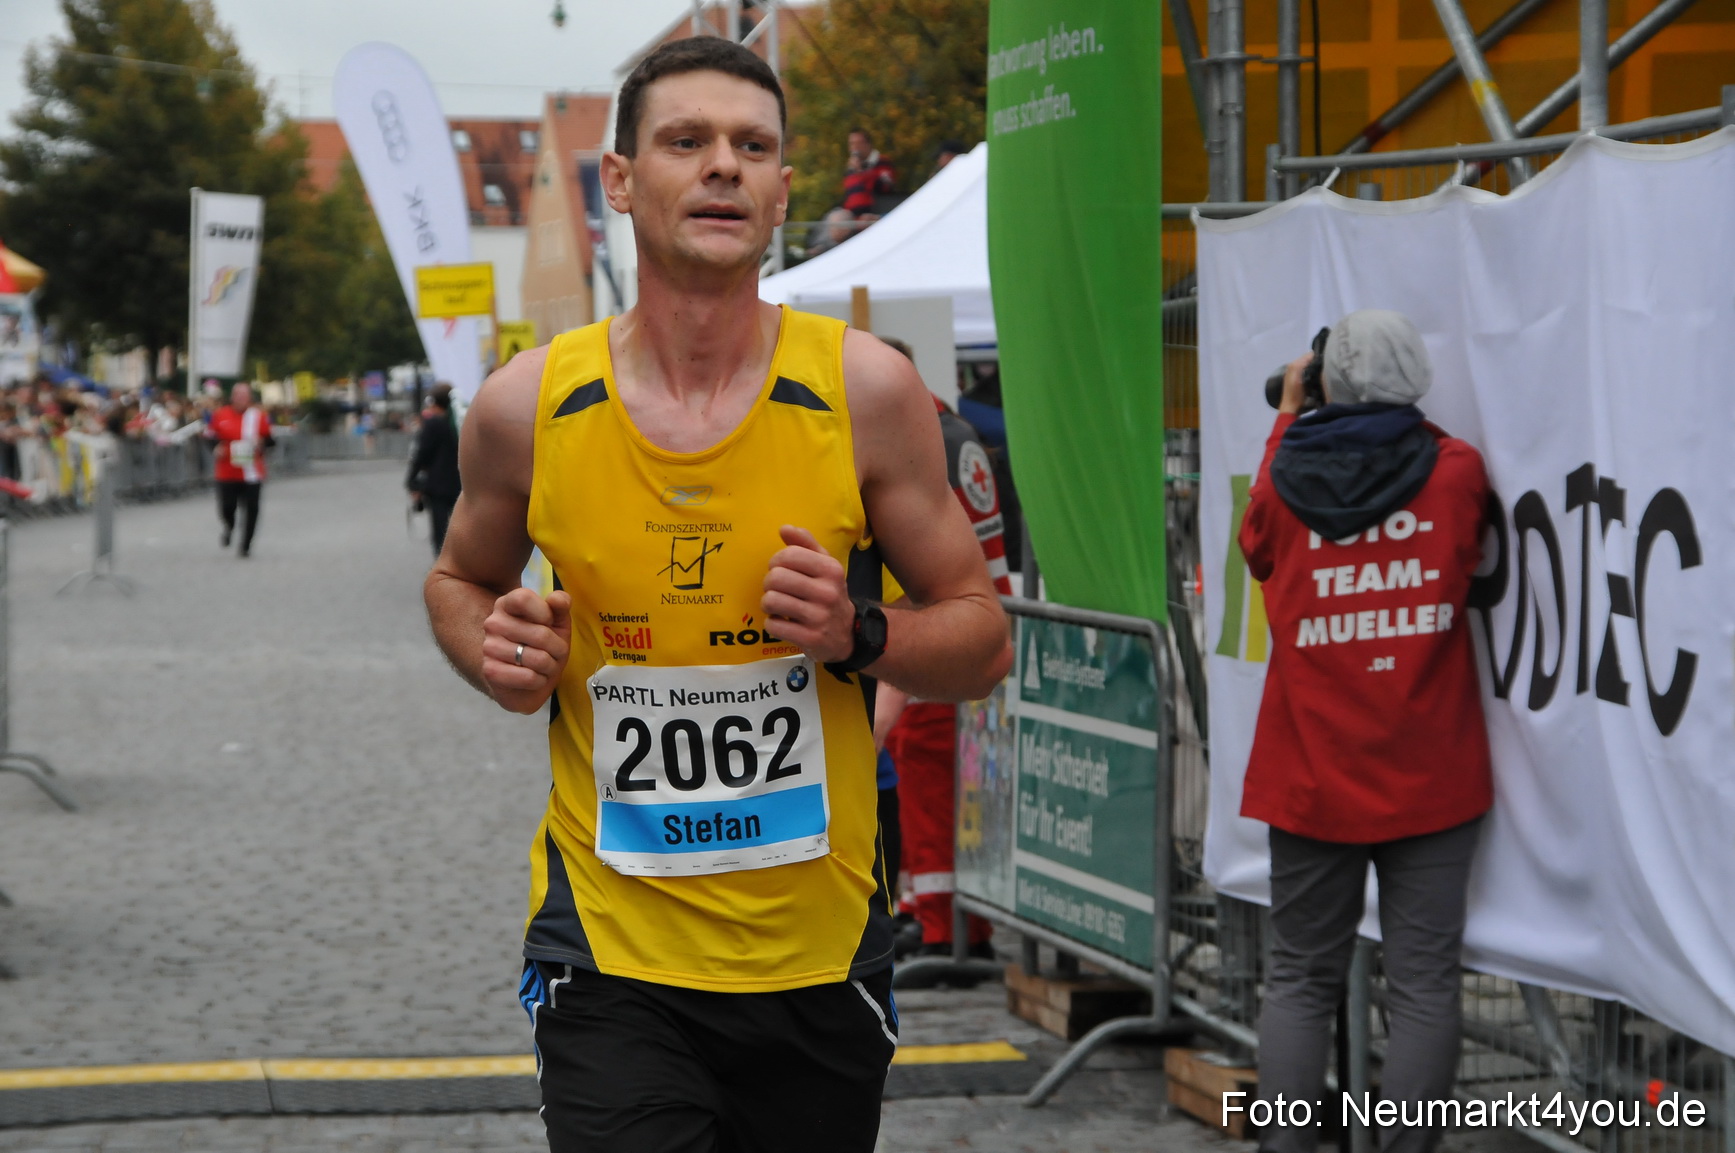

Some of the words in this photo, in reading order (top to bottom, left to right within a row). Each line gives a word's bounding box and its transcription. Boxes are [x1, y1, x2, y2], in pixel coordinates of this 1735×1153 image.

[1048, 21, 1104, 61] leben.
[1312, 558, 1440, 598] TEAM-
[661, 593, 724, 605] NEUMARKT
[599, 612, 649, 623] Schreinerei
[1296, 603, 1454, 648] MUELLER
[602, 626, 652, 649] Seidl
[612, 650, 647, 663] Berngau
[1367, 656, 1396, 672] .DE
[593, 685, 663, 707] PARTL
[669, 680, 780, 707] Neumarkt
[614, 706, 802, 792] 2062
[605, 786, 614, 799] A
[663, 812, 761, 845] Stefan
